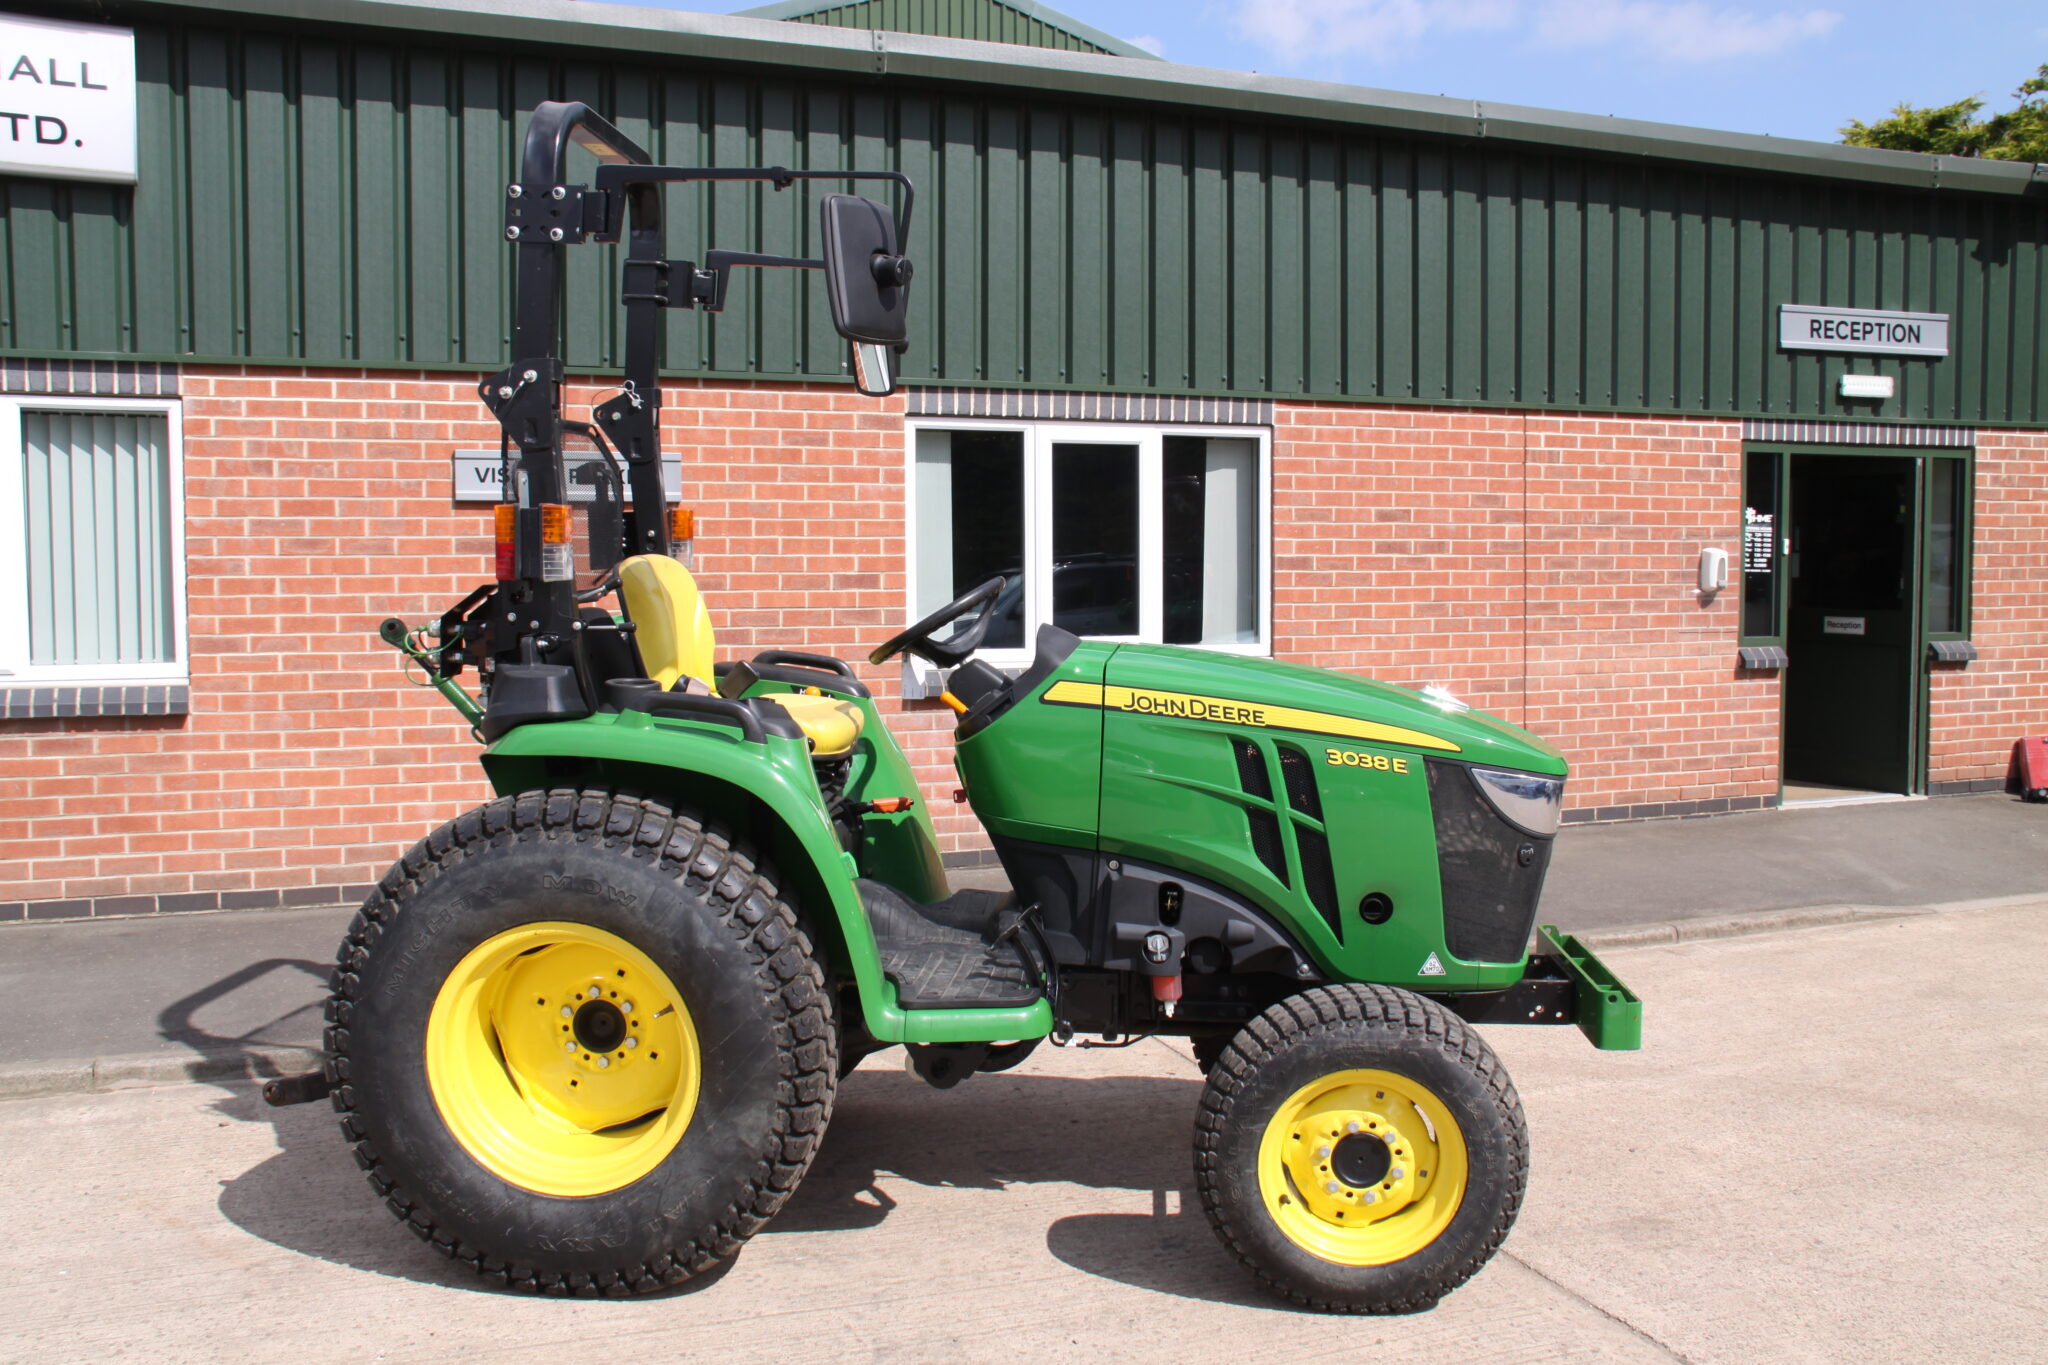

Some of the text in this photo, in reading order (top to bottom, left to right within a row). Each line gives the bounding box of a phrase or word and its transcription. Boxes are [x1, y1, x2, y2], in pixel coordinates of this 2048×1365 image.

[0, 54, 108, 91] ALL
[0, 111, 84, 148] TD.
[1810, 319, 1921, 344] RECEPTION
[475, 466, 511, 484] VIS
[1827, 620, 1862, 631] Reception
[1124, 692, 1266, 724] JOHN DEERE
[543, 874, 637, 908] MOW
